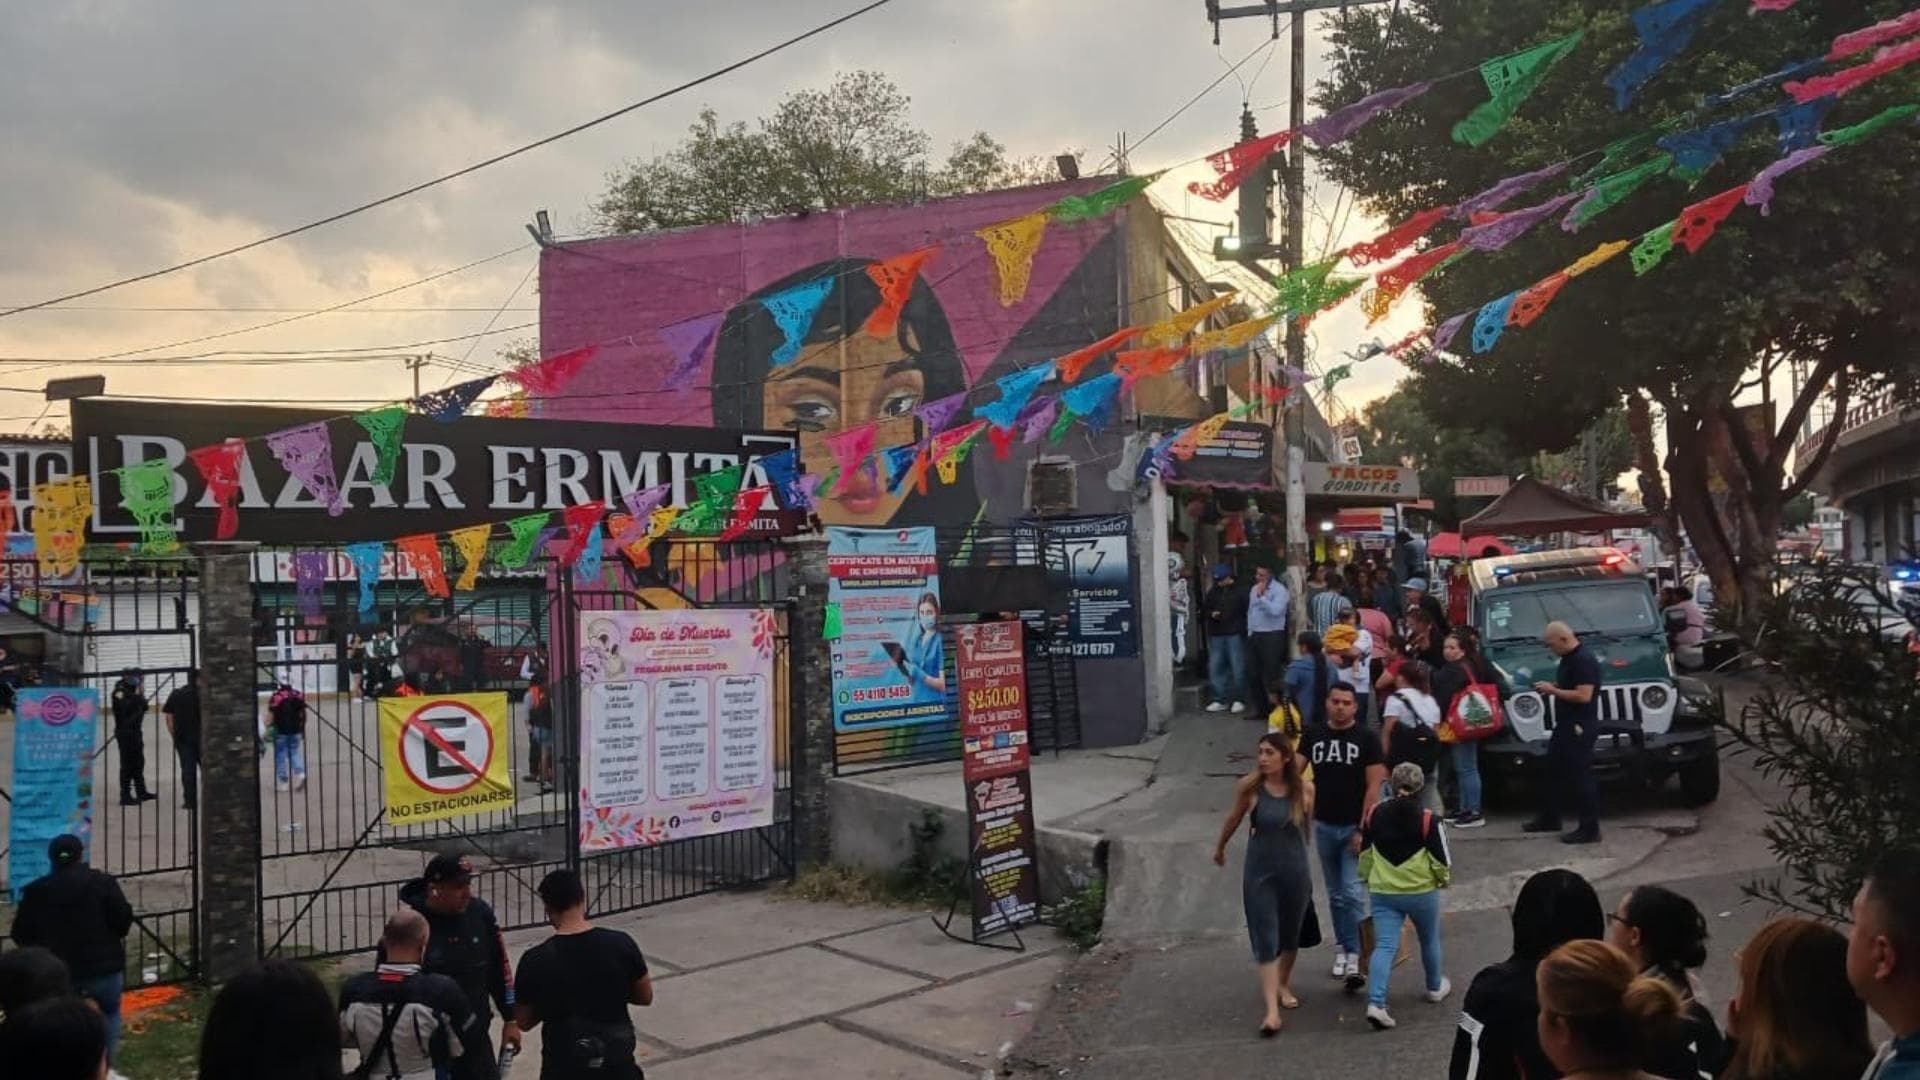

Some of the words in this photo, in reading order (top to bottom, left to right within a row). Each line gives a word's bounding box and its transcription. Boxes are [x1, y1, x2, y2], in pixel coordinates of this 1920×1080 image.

[1328, 467, 1399, 480] TACOS
[1072, 588, 1119, 598] Servicios
[968, 686, 1020, 712] $250.00
[1312, 739, 1360, 765] GAP
[390, 805, 411, 817] NO
[413, 791, 514, 815] ESTACIONARSE
